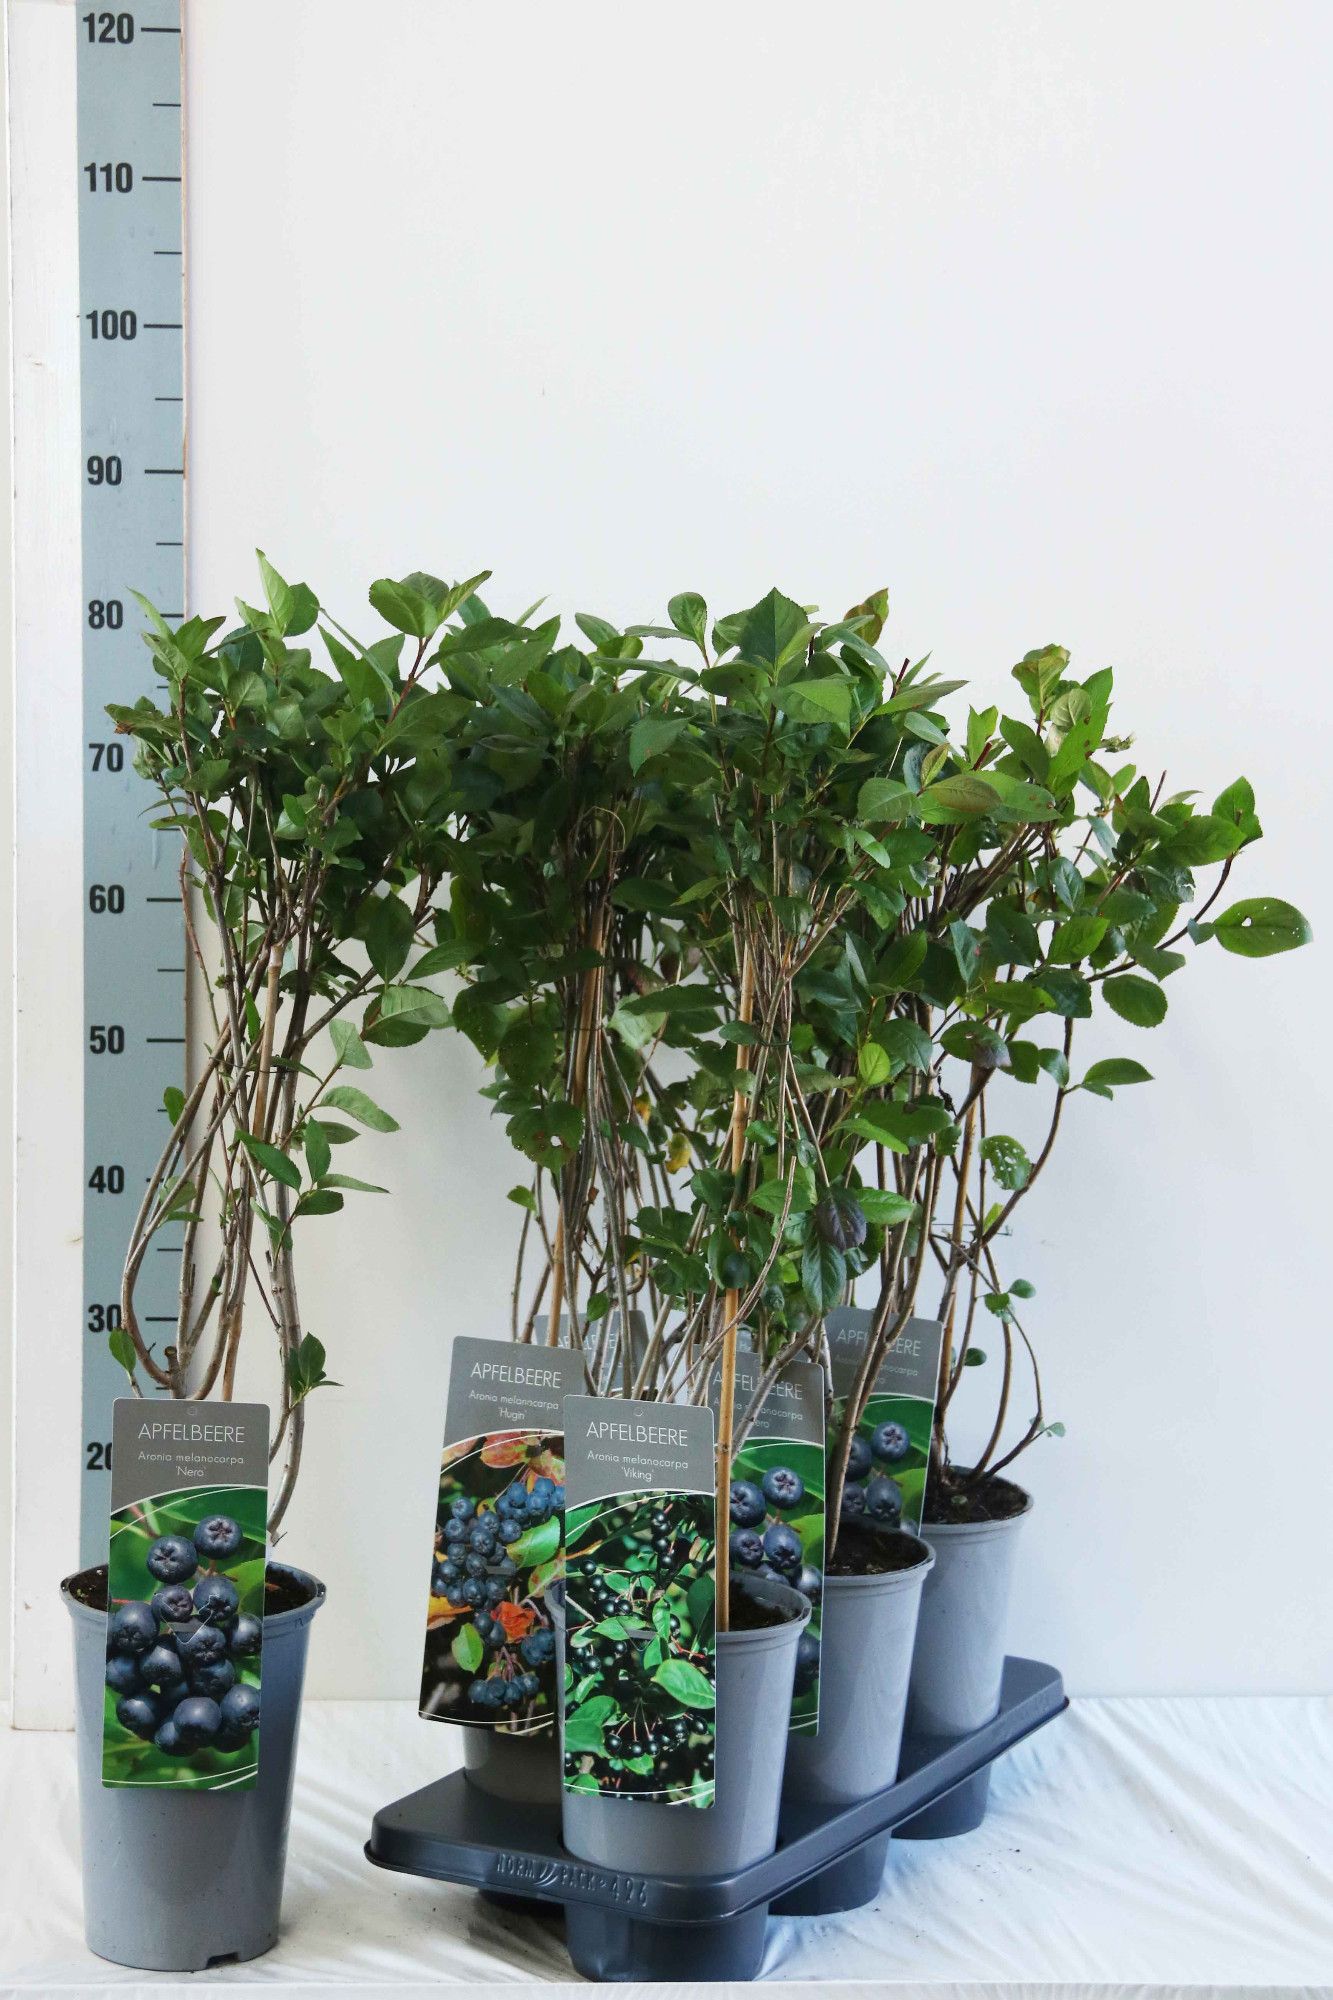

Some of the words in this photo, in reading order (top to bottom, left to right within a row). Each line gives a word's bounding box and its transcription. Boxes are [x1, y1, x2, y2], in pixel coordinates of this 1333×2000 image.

[83, 13, 133, 44] 120
[85, 163, 132, 193] 110
[87, 310, 136, 340] 100
[88, 456, 121, 485] 90
[88, 600, 123, 629] 80
[89, 744, 123, 772] 70
[90, 885, 124, 914] 60
[90, 1025, 124, 1054] 50
[89, 1165, 124, 1194] 40
[88, 1304, 121, 1333] 30
[470, 1362, 562, 1388] APFELBEERE
[468, 1389, 498, 1402] Aronia
[500, 1395, 559, 1411] melanocarpa
[138, 1423, 245, 1443] APFELBEERE
[586, 1421, 688, 1447] APFELBEERE
[138, 1451, 172, 1462] Aronia
[176, 1452, 244, 1465] melanocarpa
[587, 1450, 619, 1463] Aronia
[623, 1455, 688, 1470] melanocarpa
